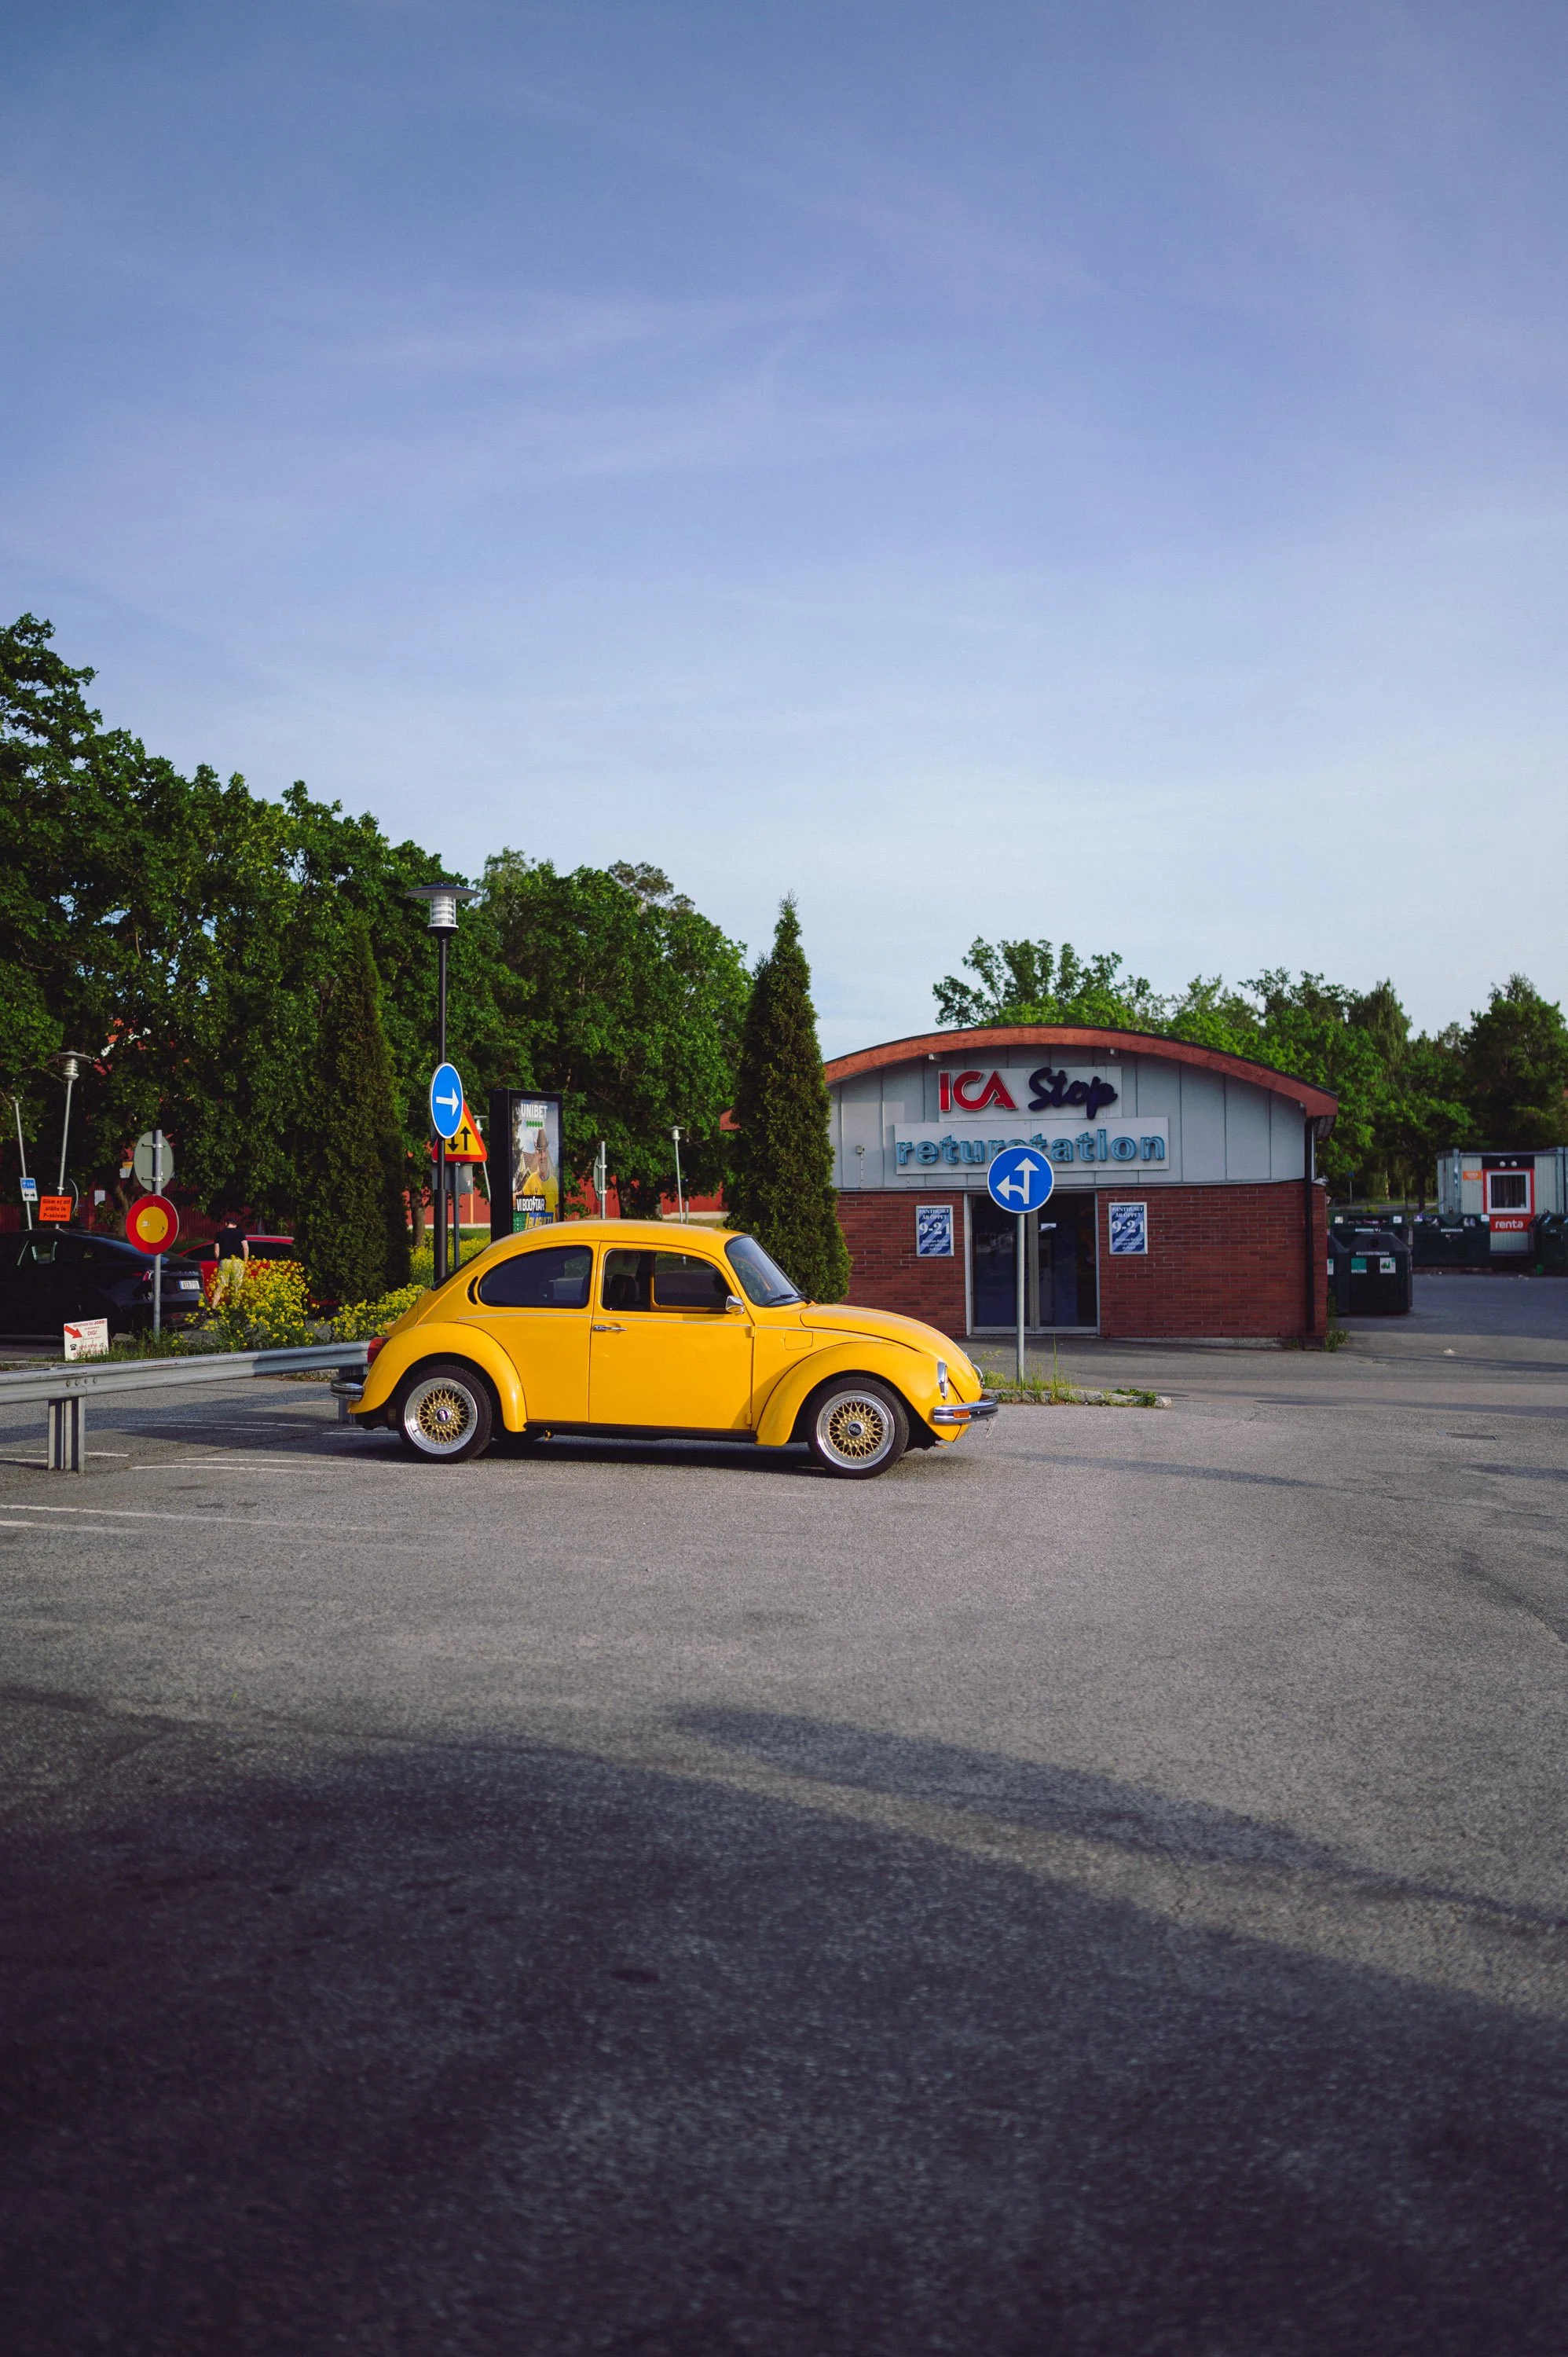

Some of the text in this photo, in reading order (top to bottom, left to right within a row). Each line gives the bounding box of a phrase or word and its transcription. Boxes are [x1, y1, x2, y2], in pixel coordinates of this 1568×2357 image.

[940, 1066, 1119, 1120] ICA Stop
[521, 1103, 548, 1119] UNIBET
[516, 1198, 522, 1211] VI
[919, 1222, 950, 1235] 9-21
[1112, 1220, 1145, 1233] 9-21
[1495, 1219, 1523, 1229] renta
